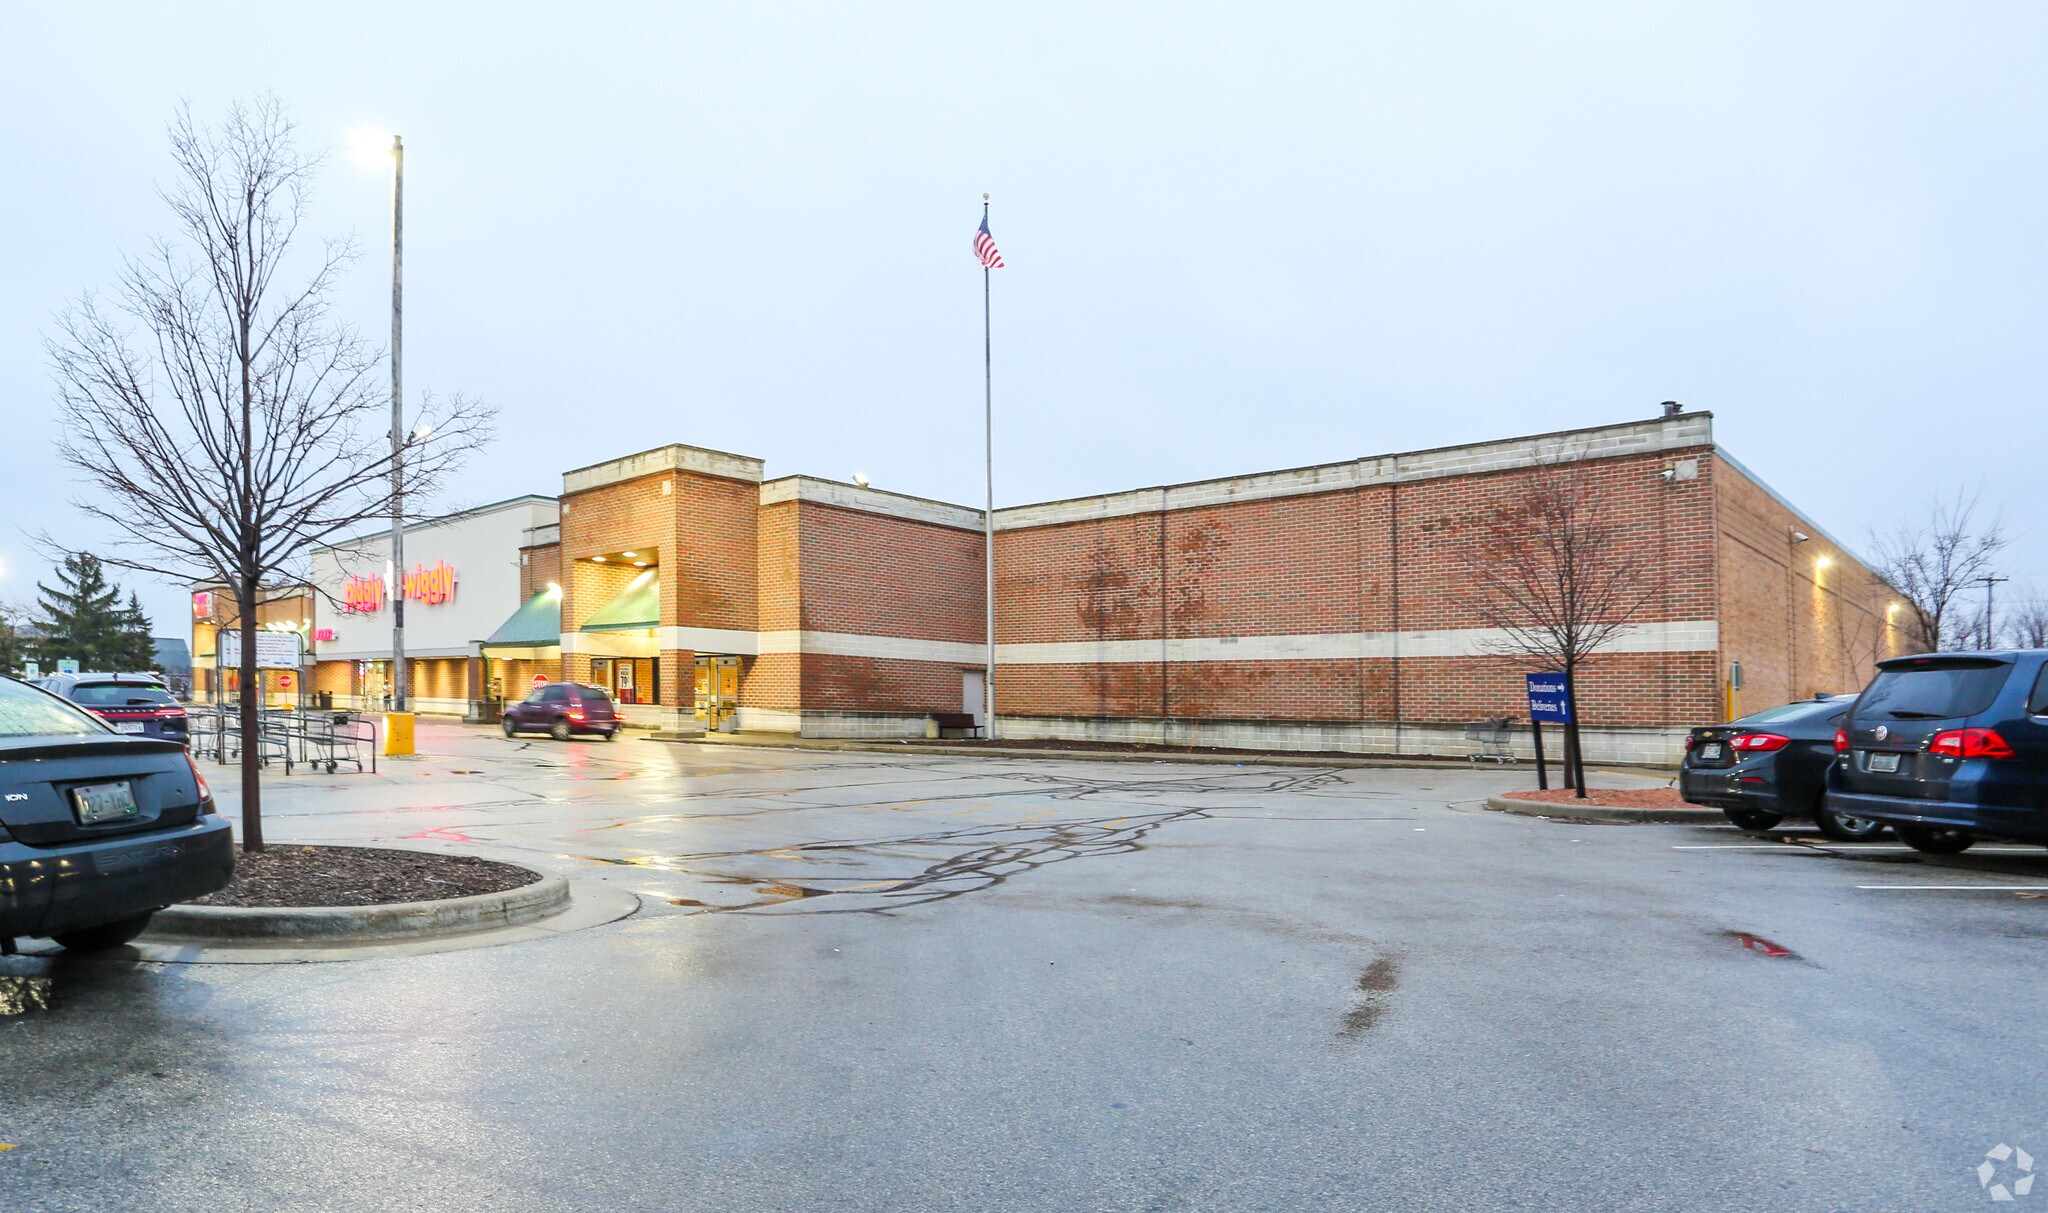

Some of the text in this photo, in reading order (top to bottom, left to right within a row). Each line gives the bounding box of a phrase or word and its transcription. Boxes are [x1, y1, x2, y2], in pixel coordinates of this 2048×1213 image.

[403, 559, 454, 605] wiggly
[1528, 681, 1557, 693] Donations
[1531, 699, 1558, 712] Deliveries
[4, 792, 29, 803] ION
